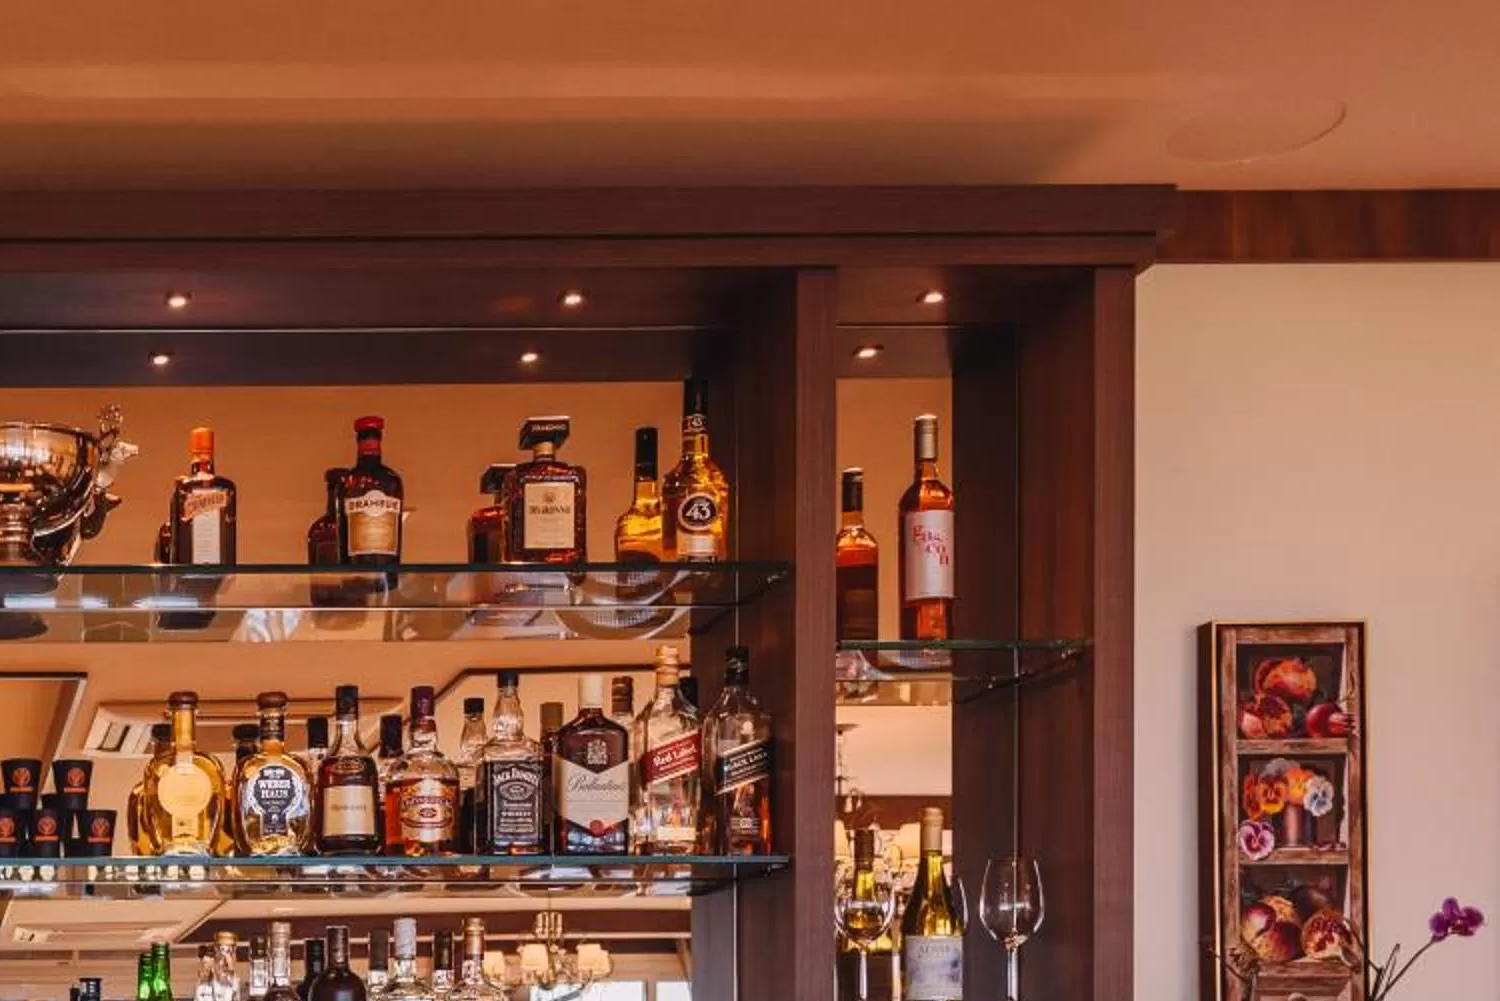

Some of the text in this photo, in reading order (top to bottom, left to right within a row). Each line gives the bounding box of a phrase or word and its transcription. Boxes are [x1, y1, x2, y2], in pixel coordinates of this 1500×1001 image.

[683, 502, 711, 522] 43
[653, 746, 697, 766] Red Label
[259, 780, 291, 790] WEBER
[261, 789, 288, 799] HAUS
